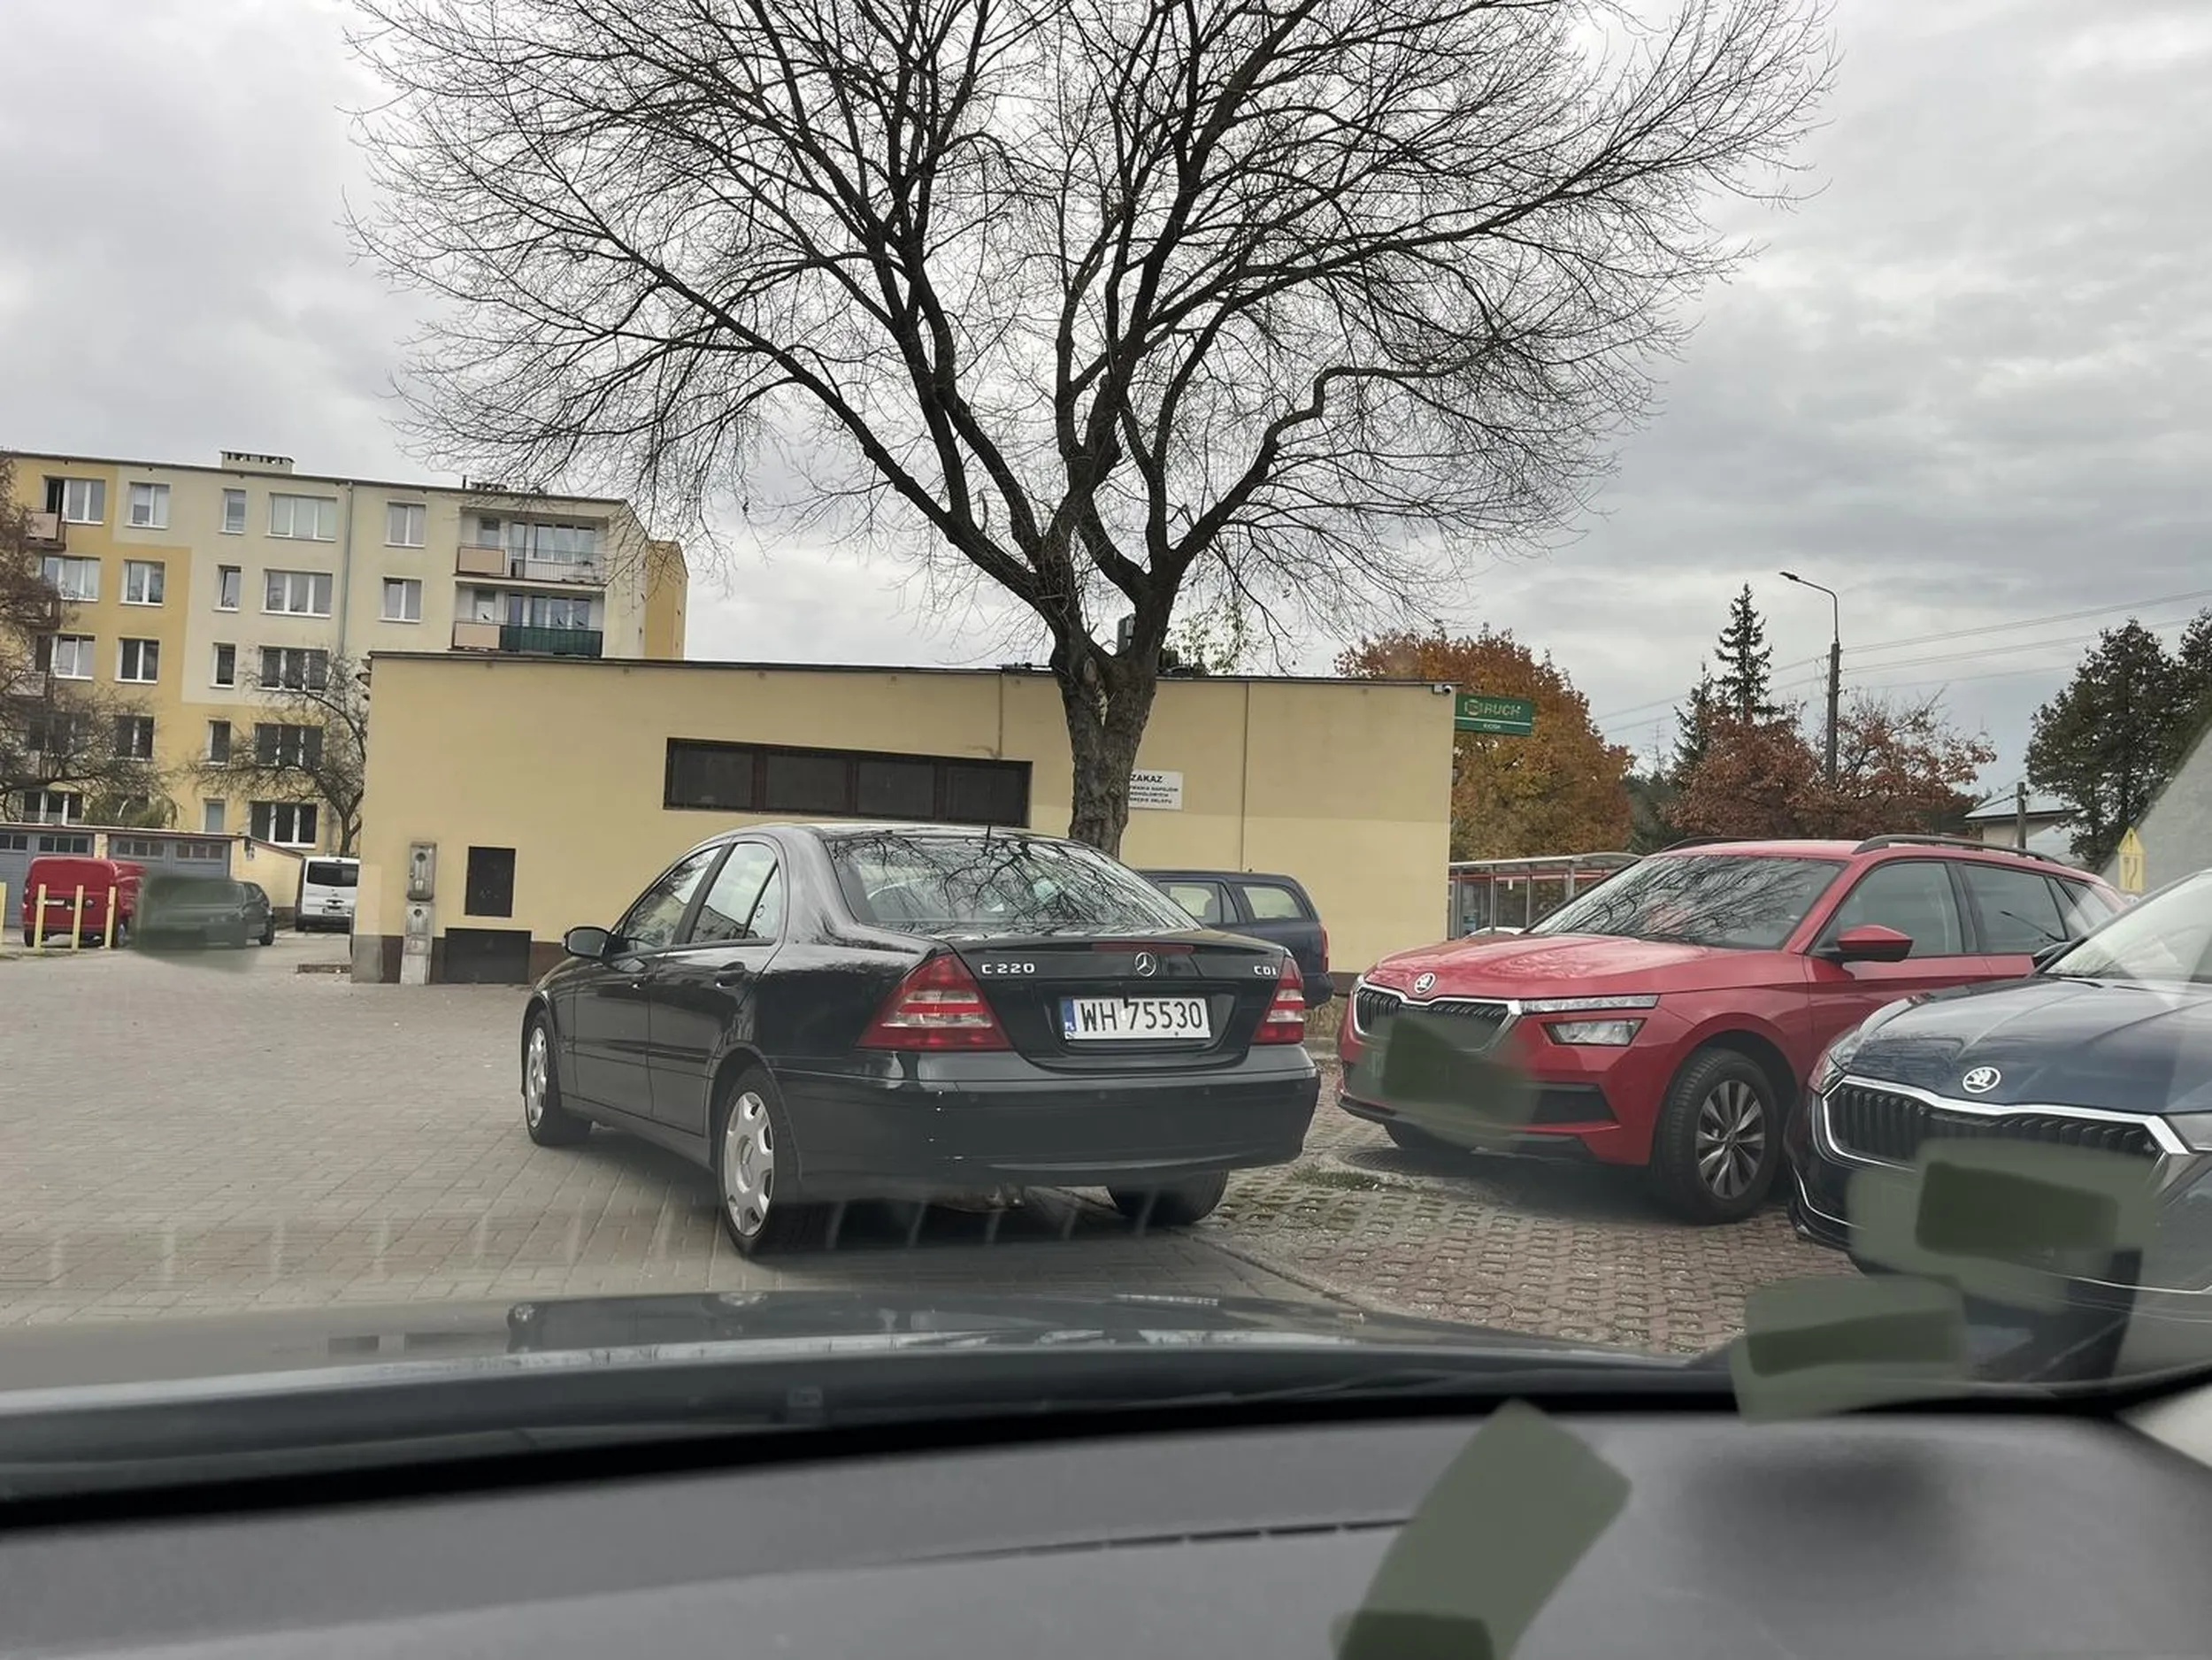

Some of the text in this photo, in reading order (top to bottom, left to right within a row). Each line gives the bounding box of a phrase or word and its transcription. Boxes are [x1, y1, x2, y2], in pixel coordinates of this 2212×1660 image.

[1130, 774, 1164, 783] ZAKAZ
[981, 963, 1035, 974] C 220
[1254, 965, 1277, 976] CDI
[1079, 1001, 1202, 1032] WH 75530
